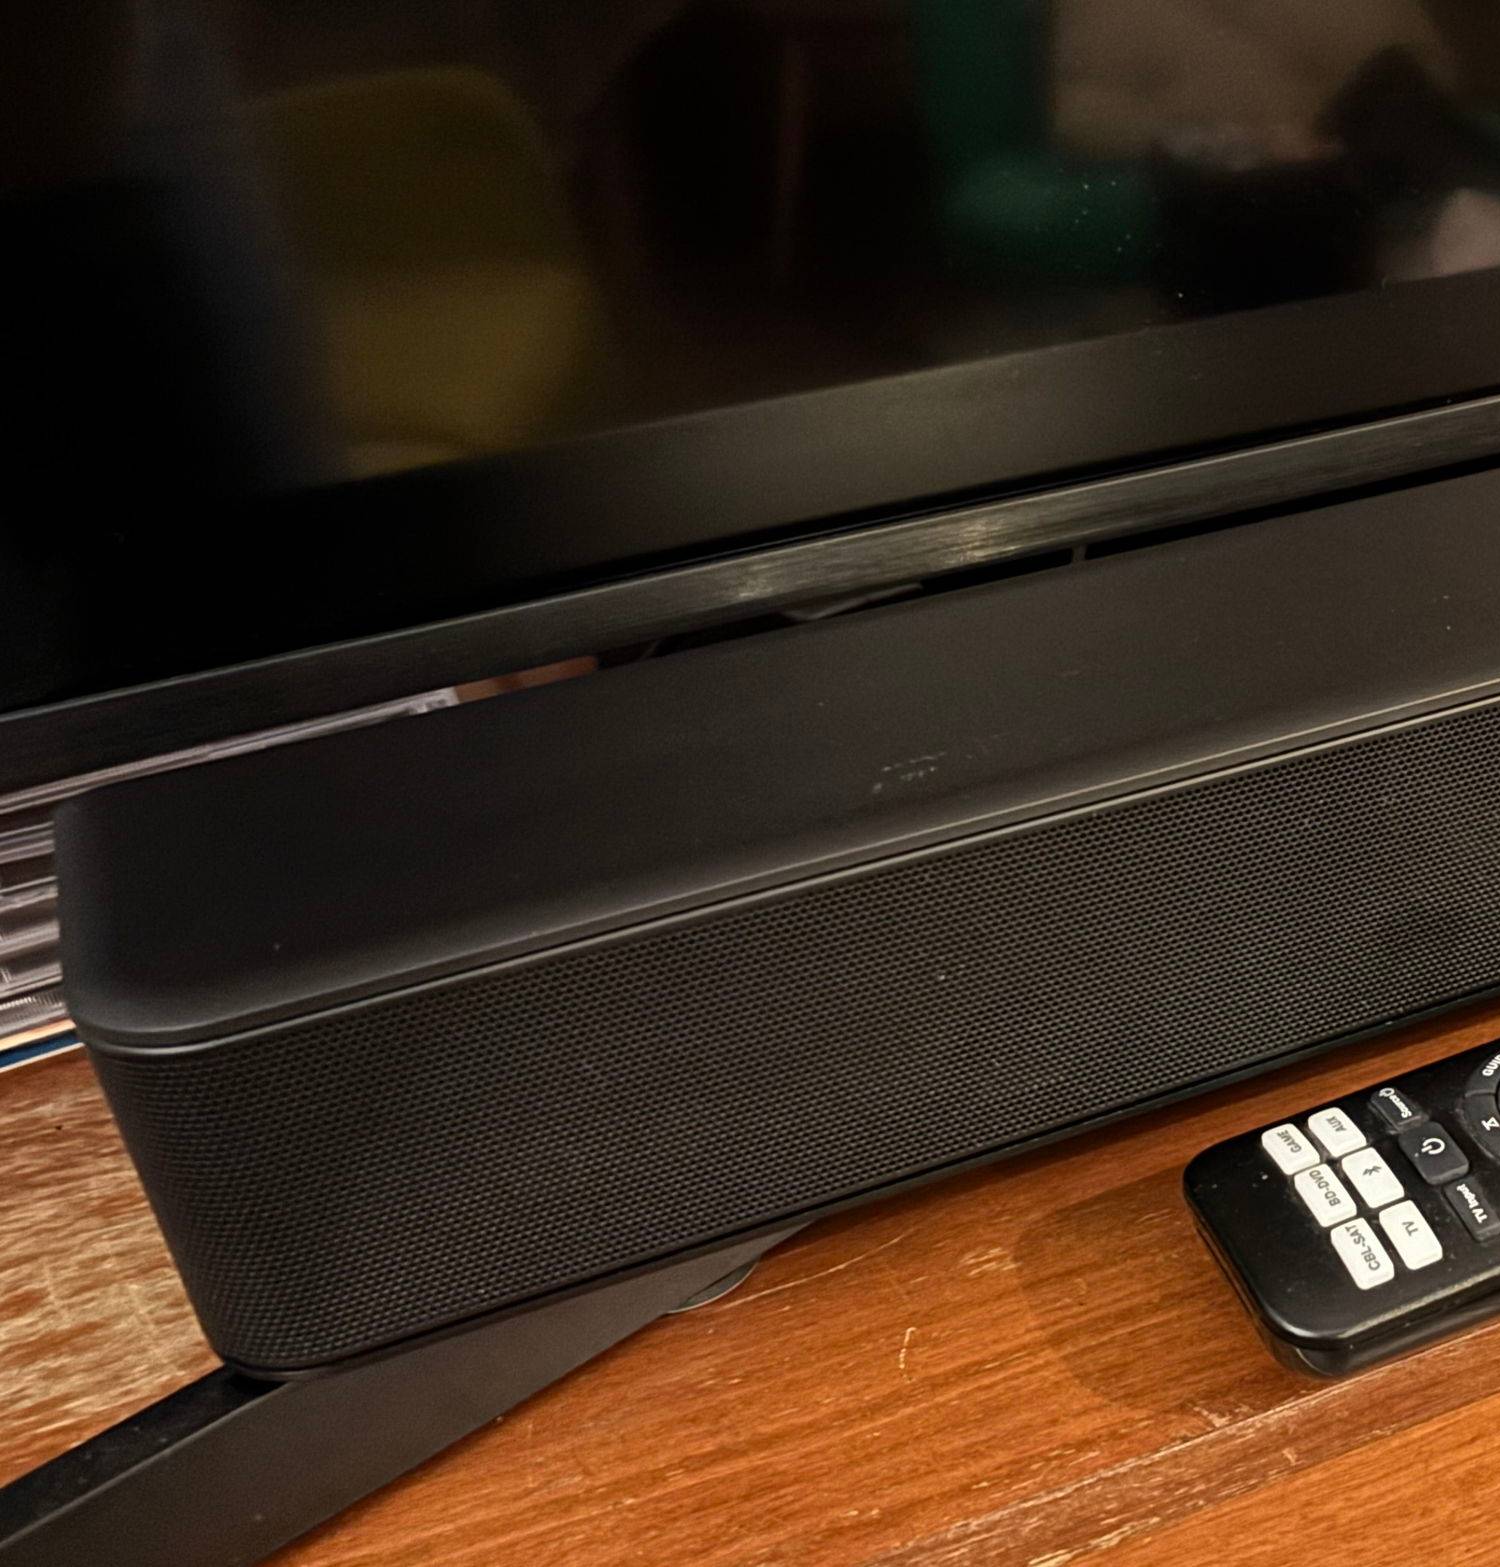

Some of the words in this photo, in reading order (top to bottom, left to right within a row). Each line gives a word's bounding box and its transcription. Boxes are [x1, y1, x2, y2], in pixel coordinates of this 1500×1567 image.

[1326, 1116, 1347, 1133] AUX
[1276, 1130, 1301, 1153] GAME
[1309, 1169, 1341, 1207] BD-DVD
[1472, 1207, 1488, 1224] TV
[1402, 1220, 1418, 1237] TV
[1345, 1225, 1380, 1271] CBL-SAT
